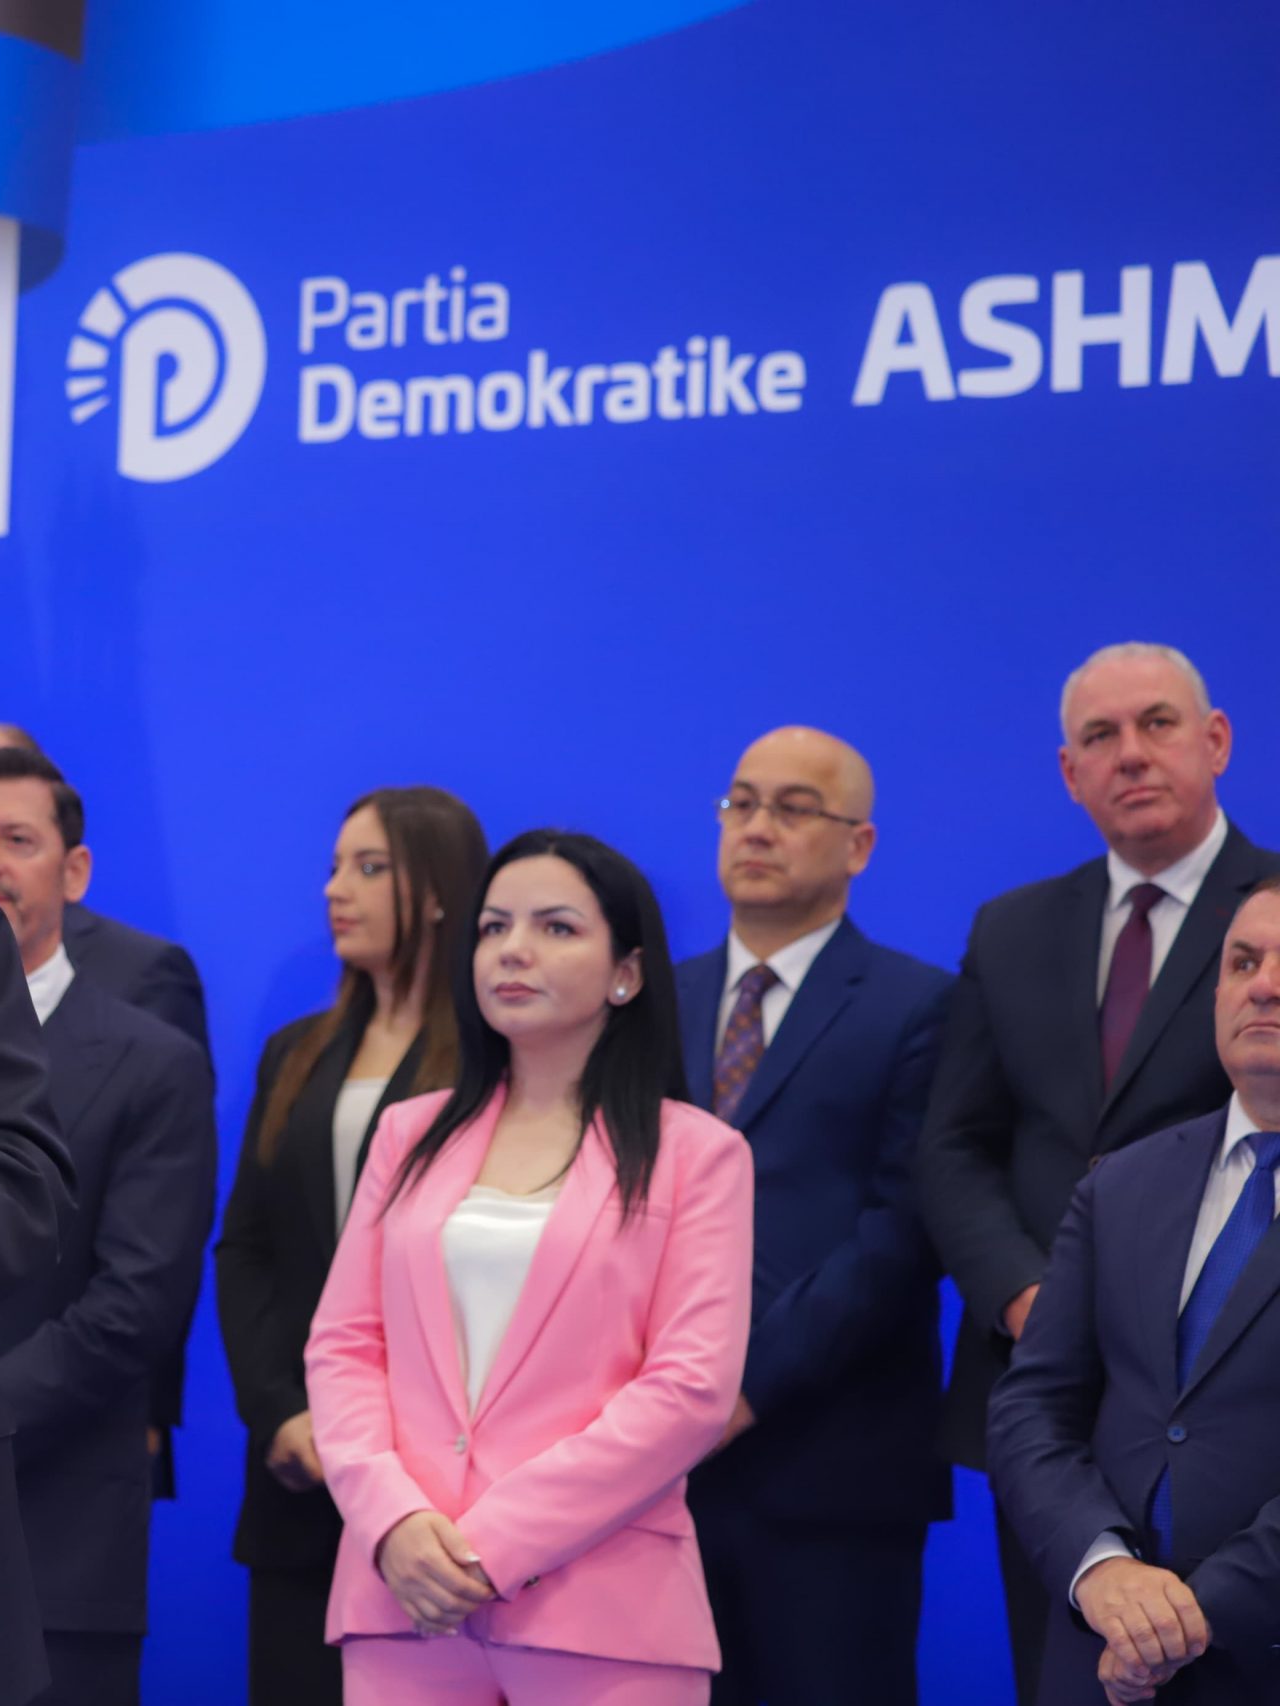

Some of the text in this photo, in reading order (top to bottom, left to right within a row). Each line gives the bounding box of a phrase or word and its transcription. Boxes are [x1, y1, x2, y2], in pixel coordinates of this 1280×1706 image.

[298, 266, 510, 354] Partia
[852, 254, 1280, 407] ASHM
[297, 336, 806, 443] Demokratike
